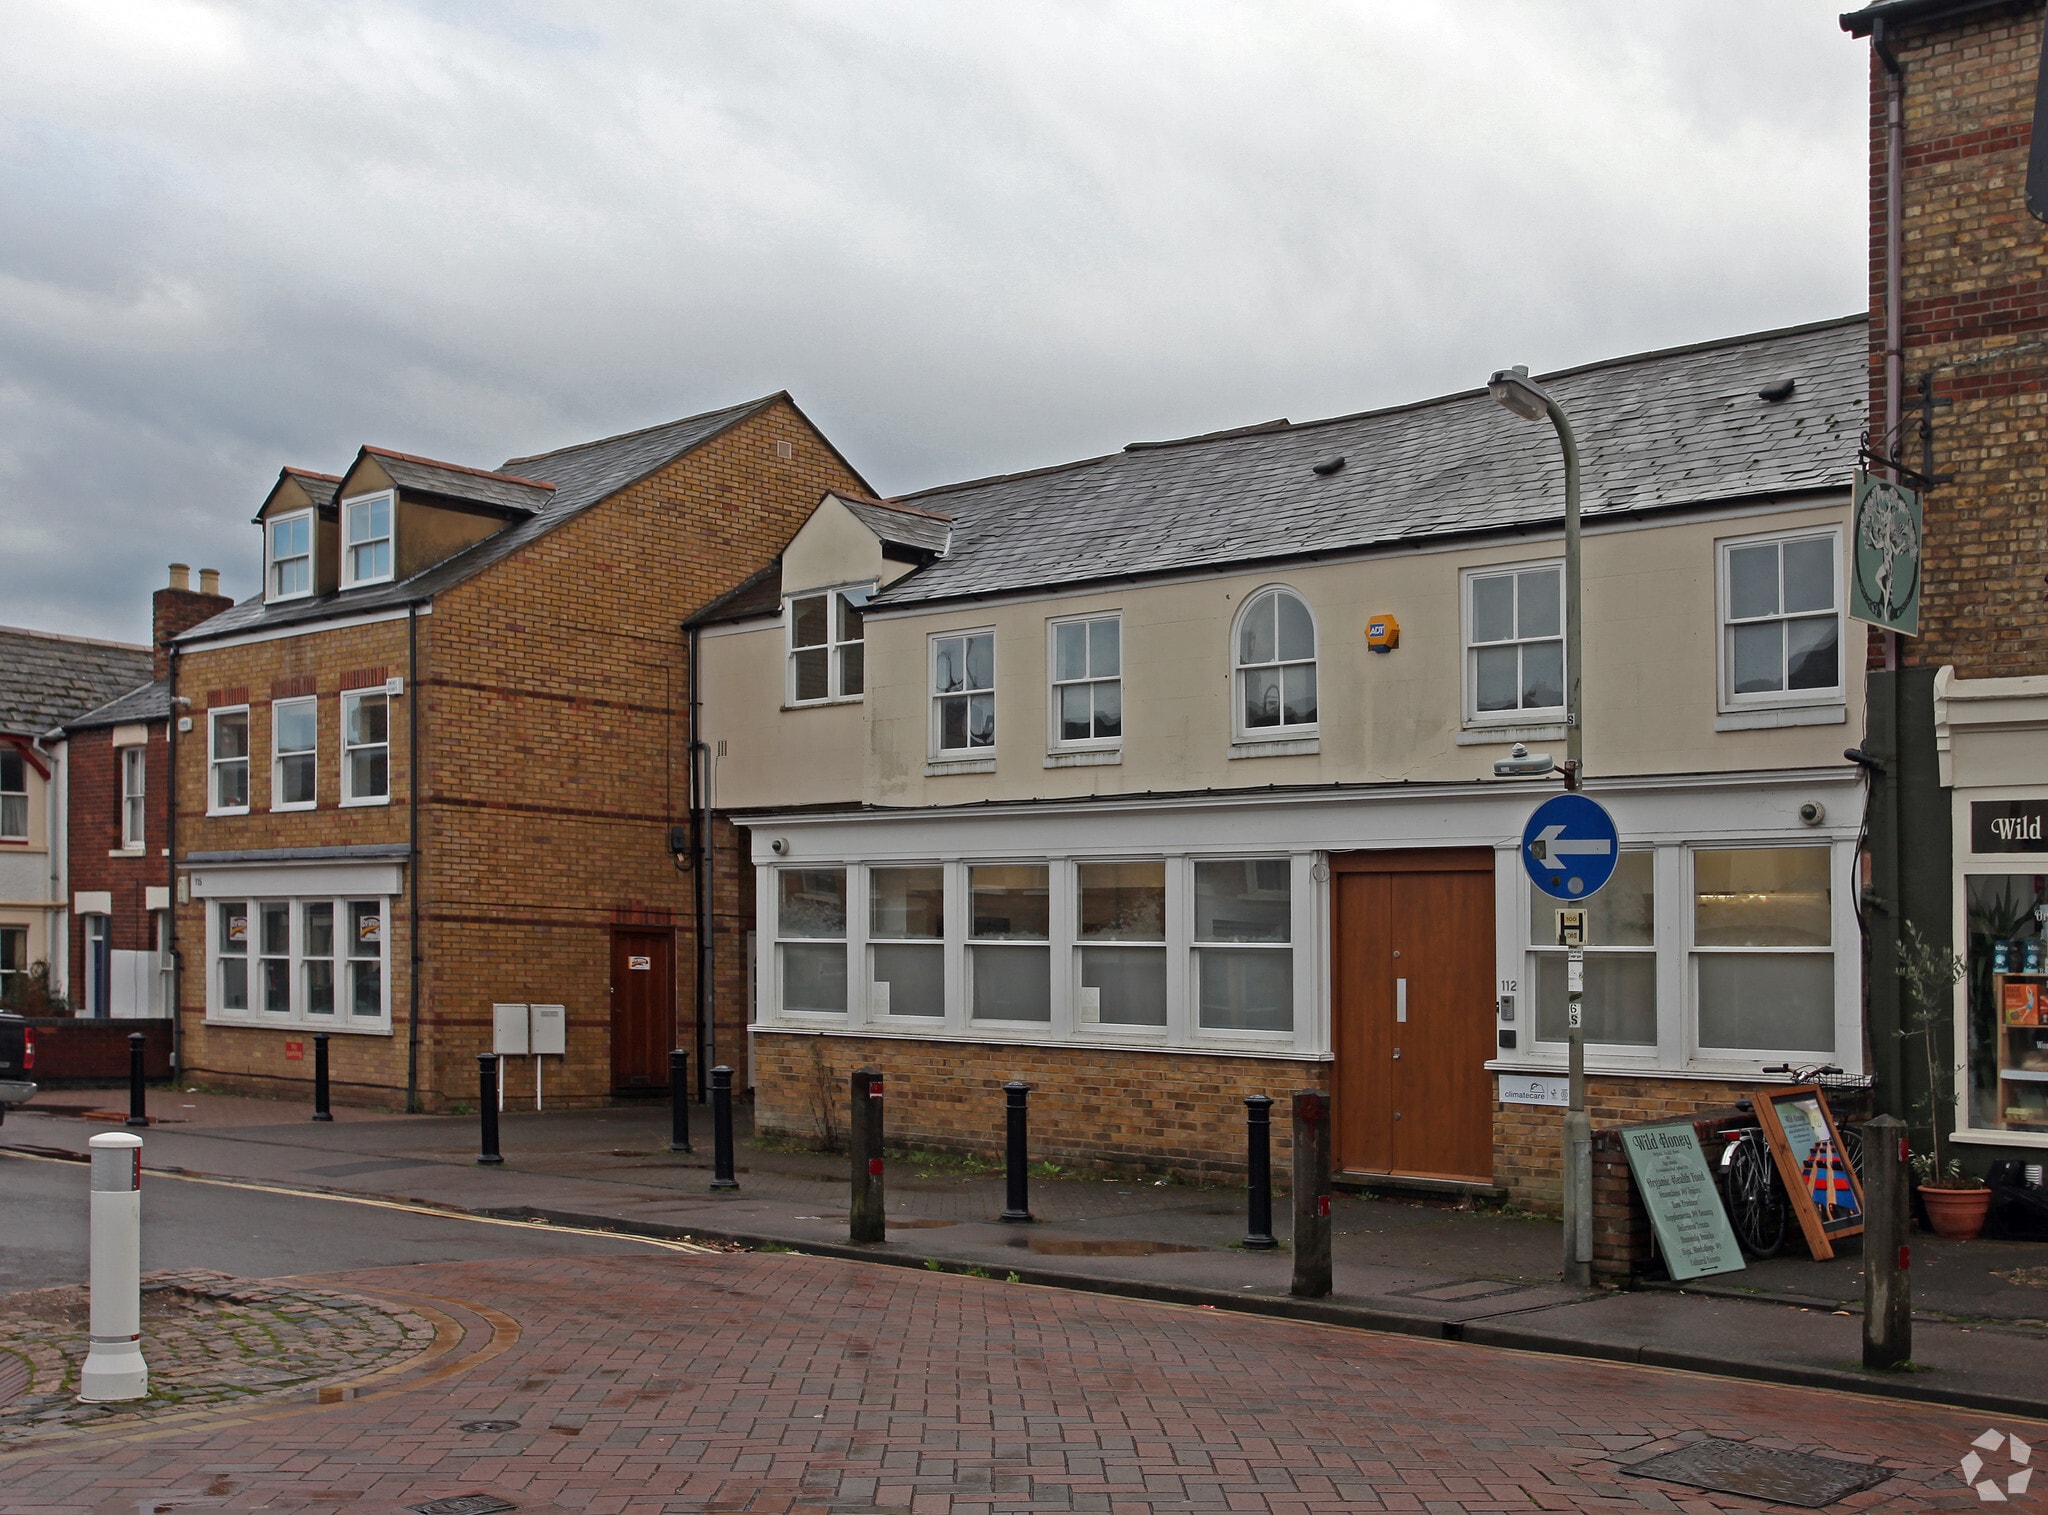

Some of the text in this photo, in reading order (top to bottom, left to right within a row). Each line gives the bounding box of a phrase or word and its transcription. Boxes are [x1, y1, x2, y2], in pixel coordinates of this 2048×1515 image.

[1370, 626, 1384, 635] ADT
[1991, 815, 2042, 840] Wild
[1501, 980, 1517, 992] 112
[1504, 1090, 1545, 1100] climatecare
[1633, 1132, 1693, 1151] Wild Honey
[1646, 1171, 1706, 1189] Organic Health Food
